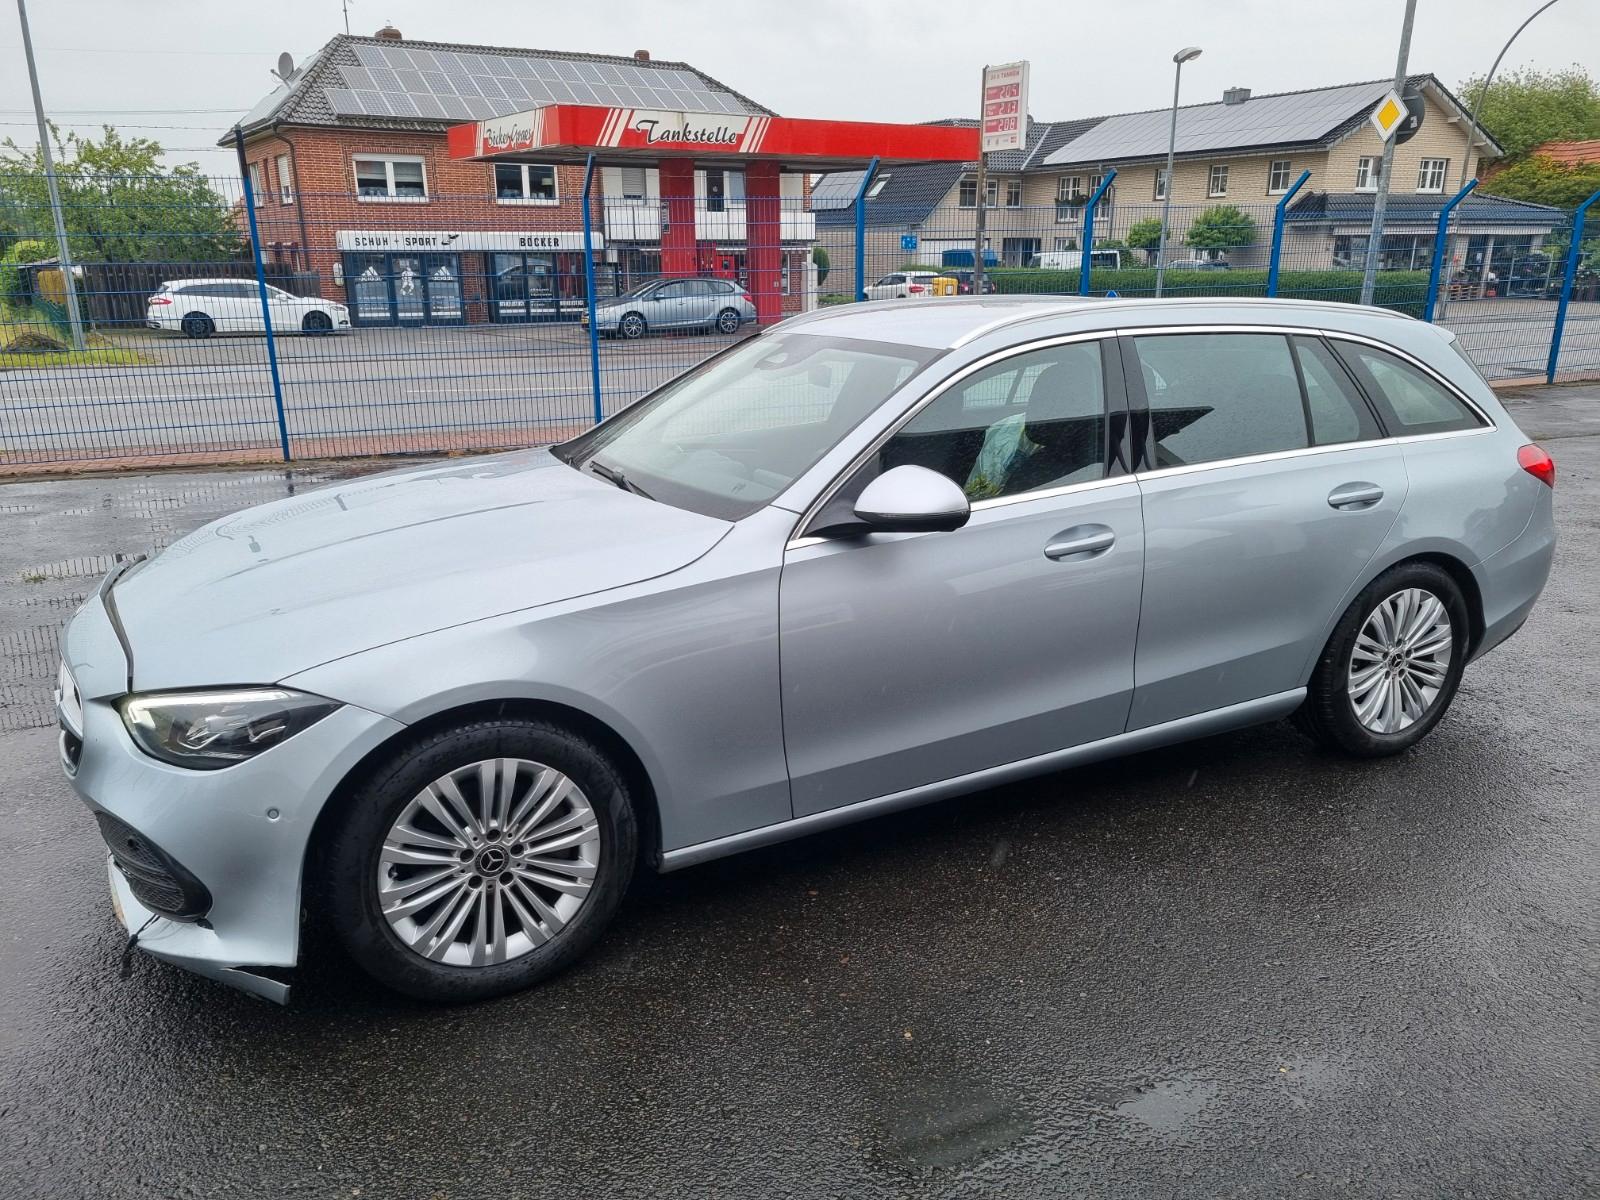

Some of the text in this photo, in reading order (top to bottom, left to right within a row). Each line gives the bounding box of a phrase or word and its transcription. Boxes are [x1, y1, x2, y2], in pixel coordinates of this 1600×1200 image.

[635, 119, 736, 144] Tankstelle
[355, 237, 389, 247] SCHUH
[405, 237, 437, 247] SPORT
[519, 235, 560, 247] BÖCKER
